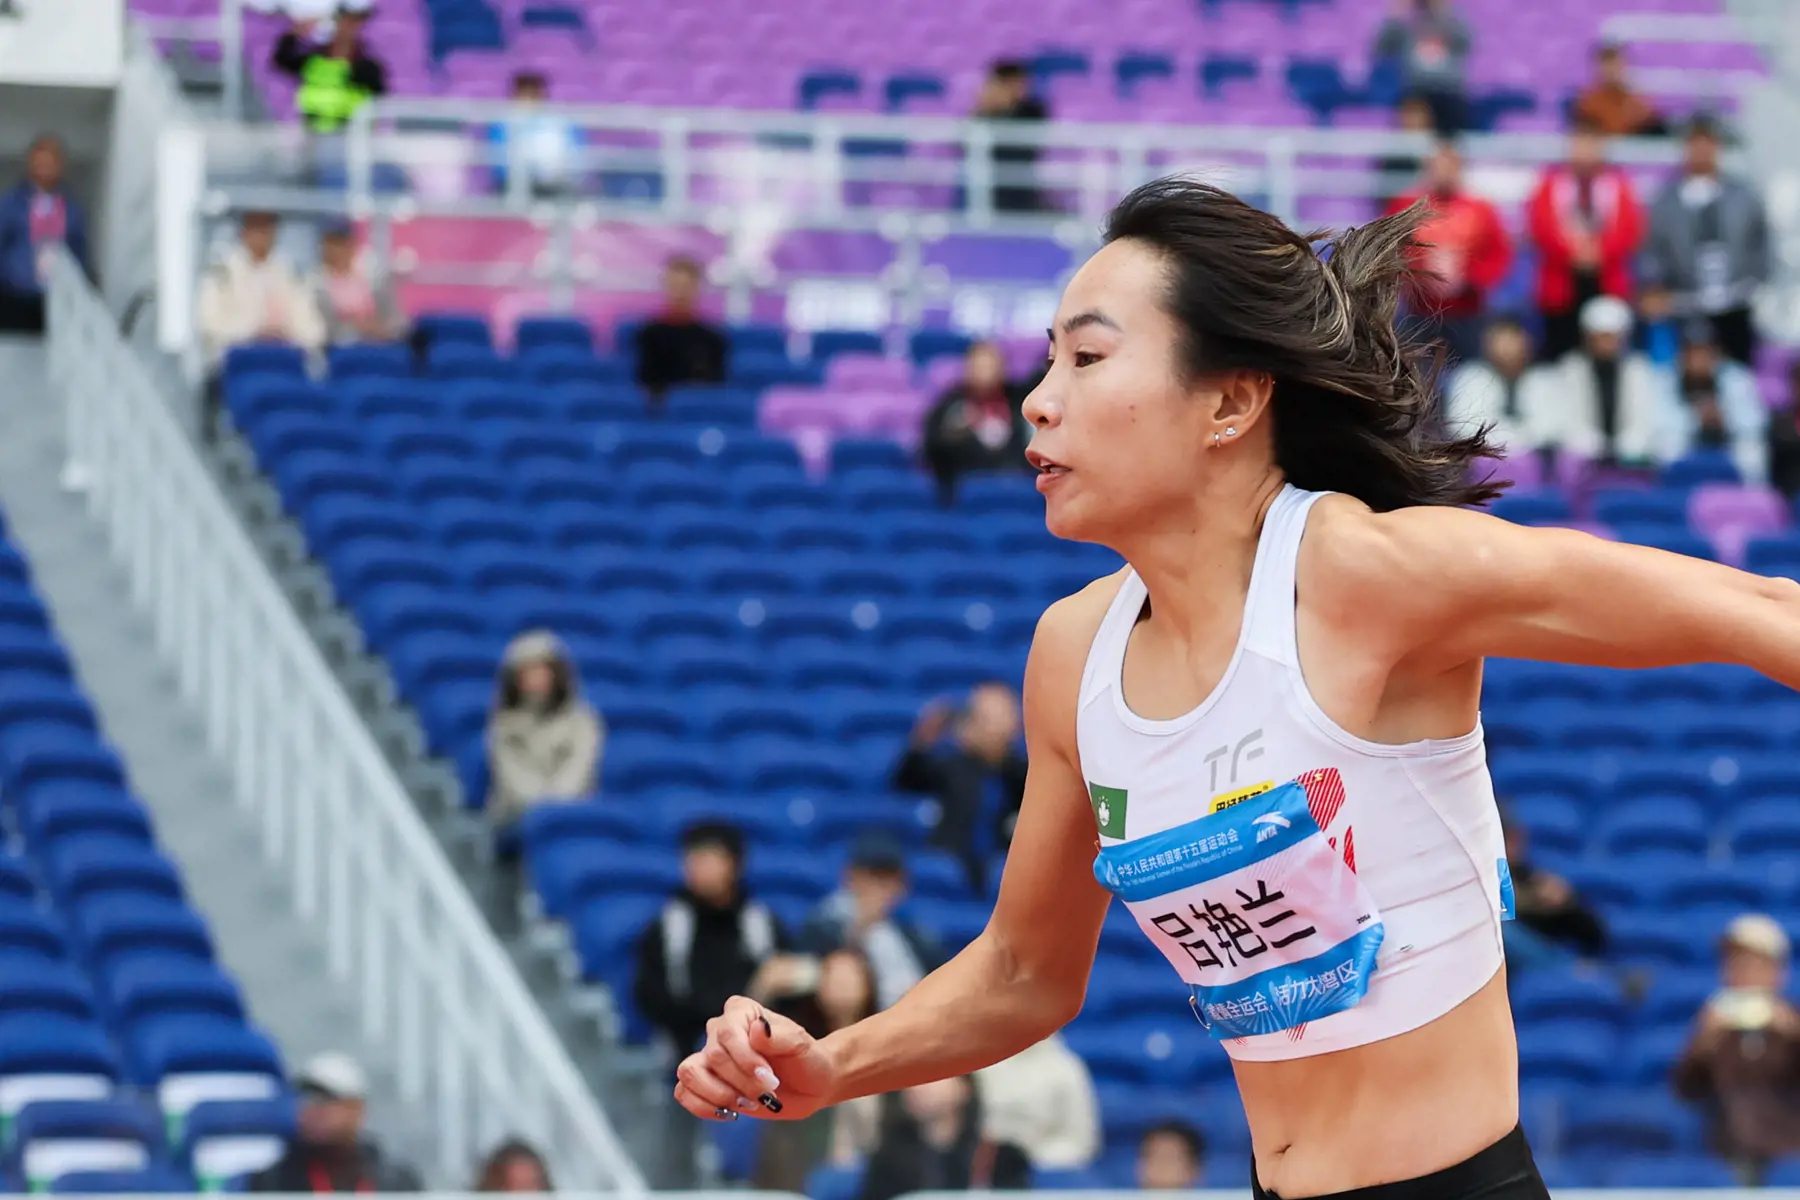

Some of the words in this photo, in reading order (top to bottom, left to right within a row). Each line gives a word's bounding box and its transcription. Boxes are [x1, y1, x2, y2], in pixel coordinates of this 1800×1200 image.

[1117, 828, 1238, 878] 中华人民共和国第十五届运动会
[1256, 825, 1278, 844] ANTA
[1150, 879, 1317, 971] 吕艳兰
